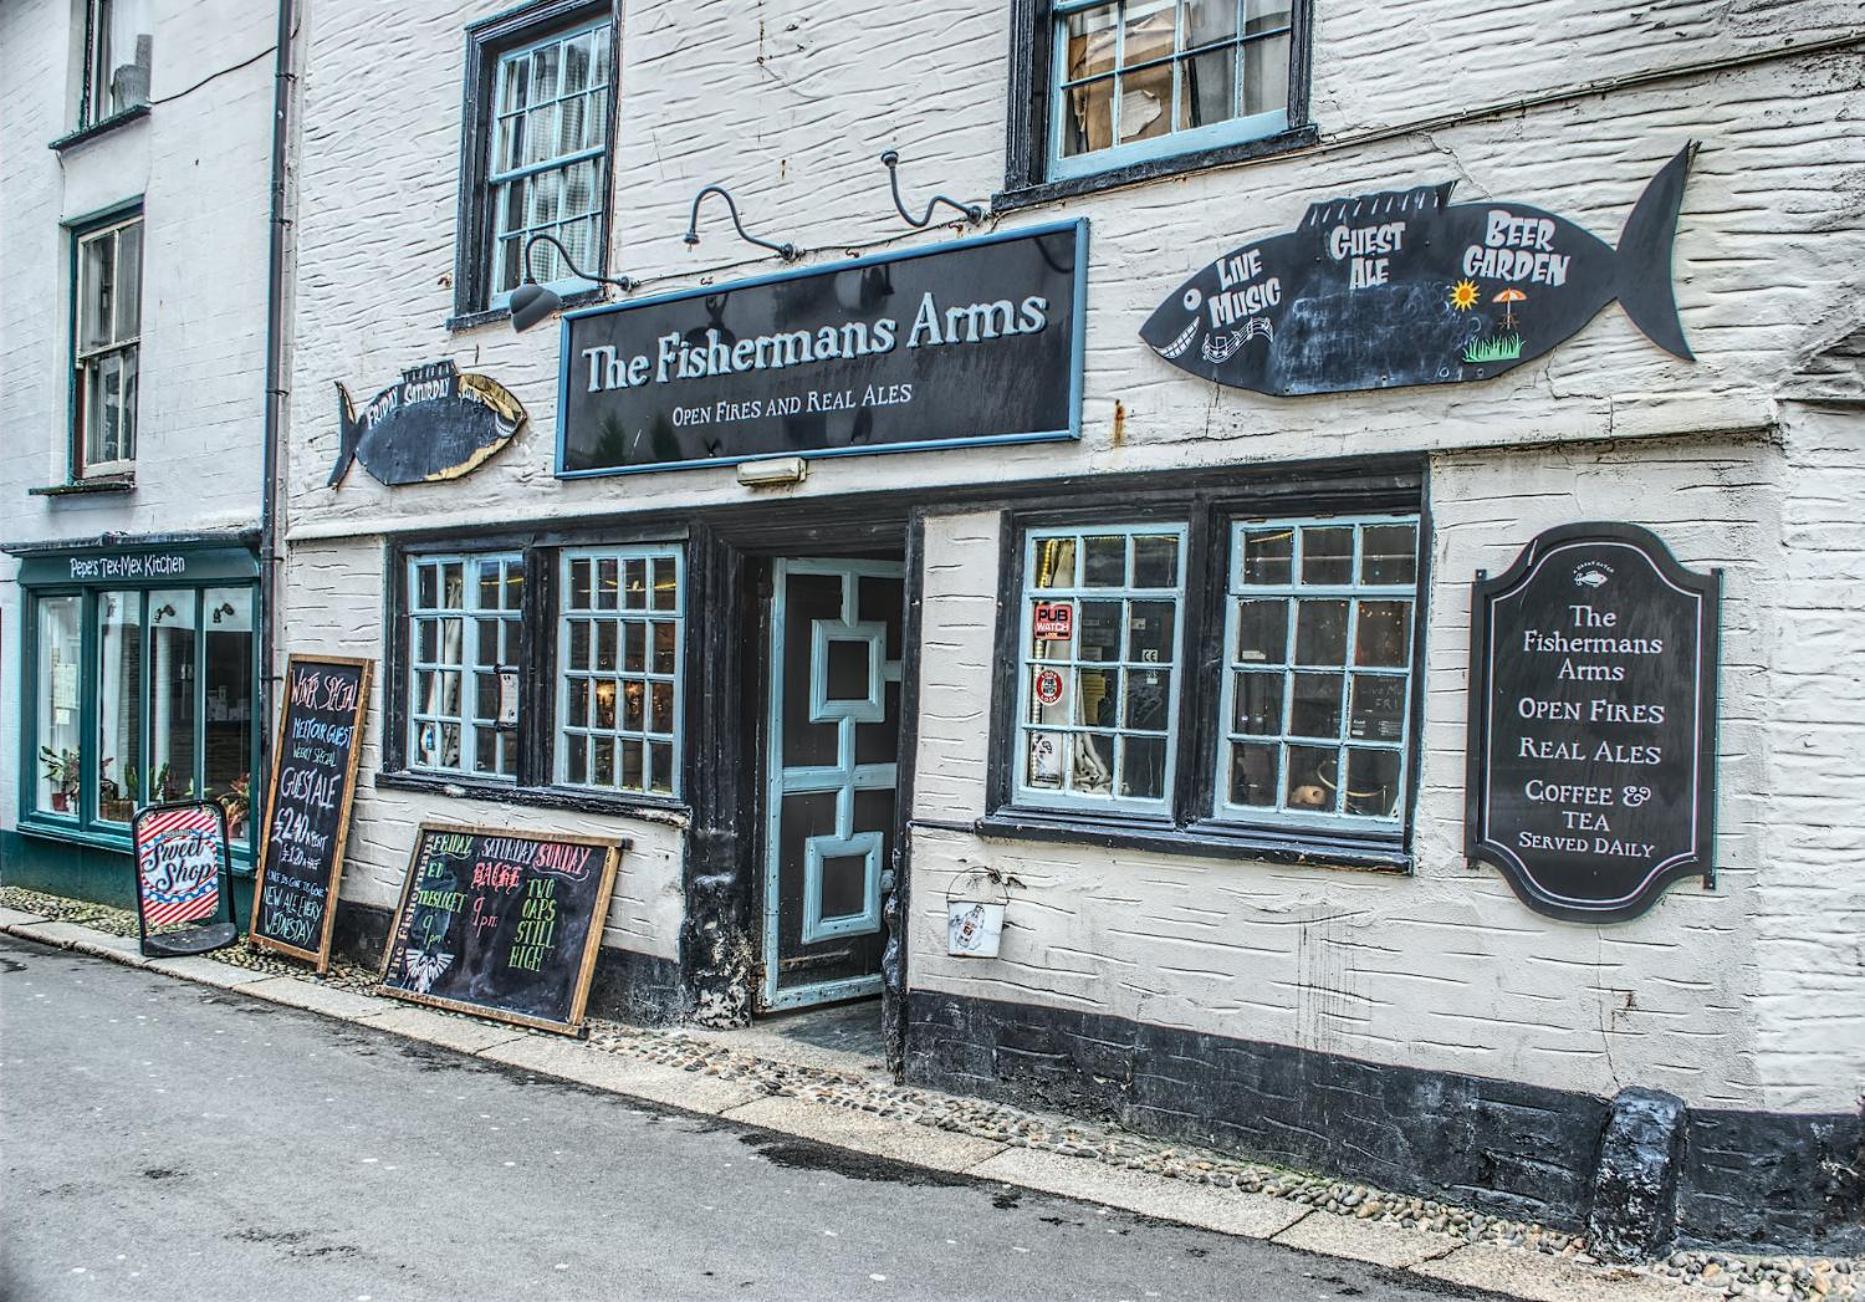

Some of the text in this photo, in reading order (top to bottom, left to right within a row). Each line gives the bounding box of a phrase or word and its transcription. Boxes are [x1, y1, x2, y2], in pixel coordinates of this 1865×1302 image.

[1329, 222, 1406, 260] GUEST
[1485, 210, 1554, 251] BEER
[1216, 249, 1262, 291] LIVE
[1350, 258, 1389, 290] ALE
[1462, 245, 1570, 287] GARDEN
[1208, 277, 1281, 329] MUSIC
[582, 292, 1048, 392] The Fishermans Arms
[366, 386, 398, 430] FRIDAY
[404, 377, 450, 406] SATURDAY
[673, 384, 912, 427] OPEN FIRES AND REAL ALES
[70, 554, 185, 578] Pepe's Tex-Mex Kitchen
[1037, 623, 1069, 631] WATCH
[1038, 609, 1068, 621] PUB
[1569, 605, 1617, 627] The
[1524, 630, 1663, 654] Fishermans
[1558, 658, 1625, 681] Arms
[1518, 698, 1665, 724] OPEN FIRES
[326, 724, 354, 749] GUEST
[1518, 737, 1661, 765] REAL ALES
[281, 766, 341, 809] GUEST ALE
[1525, 779, 1651, 807] COFFEE &
[1562, 811, 1610, 832] TEA
[142, 837, 204, 872] Sweet
[433, 835, 473, 854] FRIDAY
[482, 838, 539, 866] SATURDAY
[535, 844, 591, 875] SUNDAY
[1519, 832, 1655, 858] SERVED DAILY
[156, 859, 211, 893] Shop
[514, 921, 555, 949] STILL
[508, 946, 545, 972] HIGH
